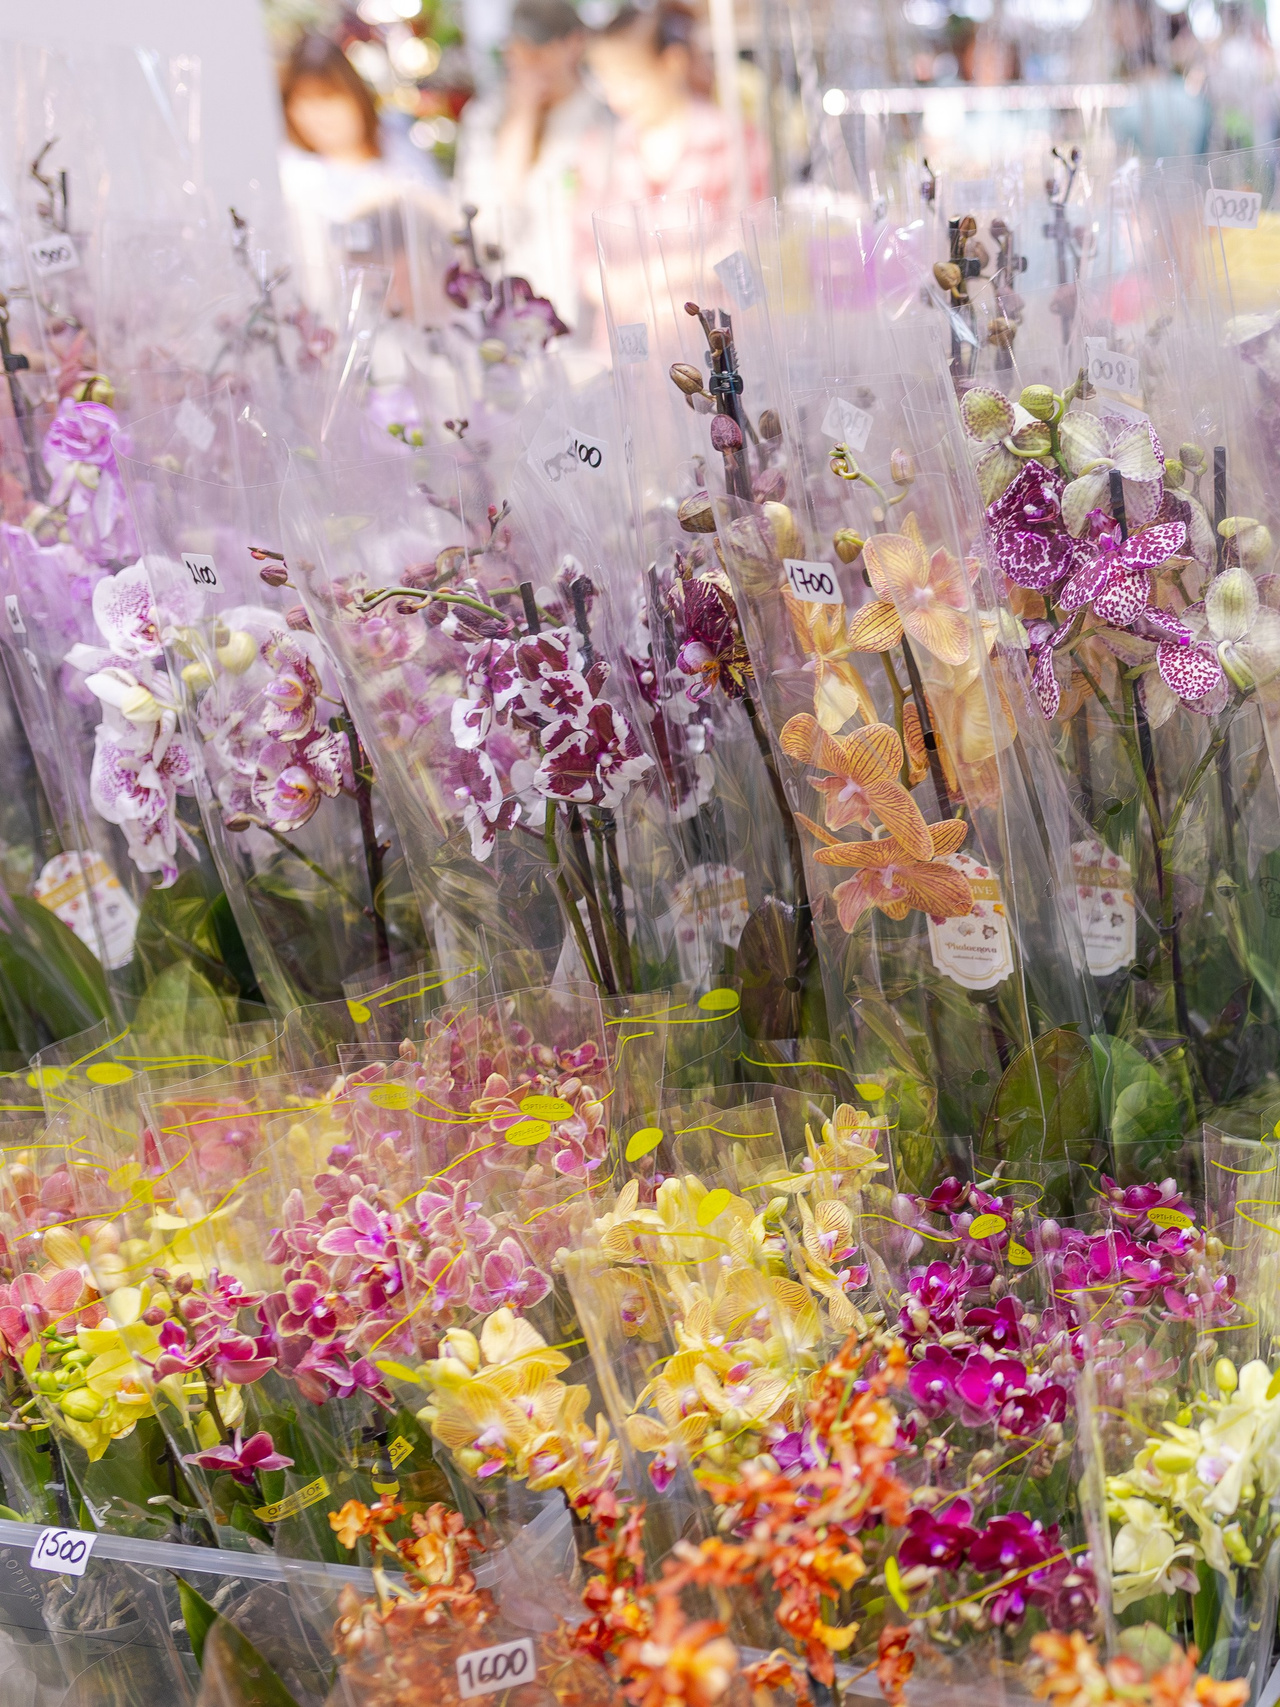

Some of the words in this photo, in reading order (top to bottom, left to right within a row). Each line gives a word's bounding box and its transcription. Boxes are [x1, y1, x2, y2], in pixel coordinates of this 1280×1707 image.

[790, 565, 834, 596] 1700
[37, 1530, 87, 1564] 1500
[461, 1648, 529, 1690] 1600
